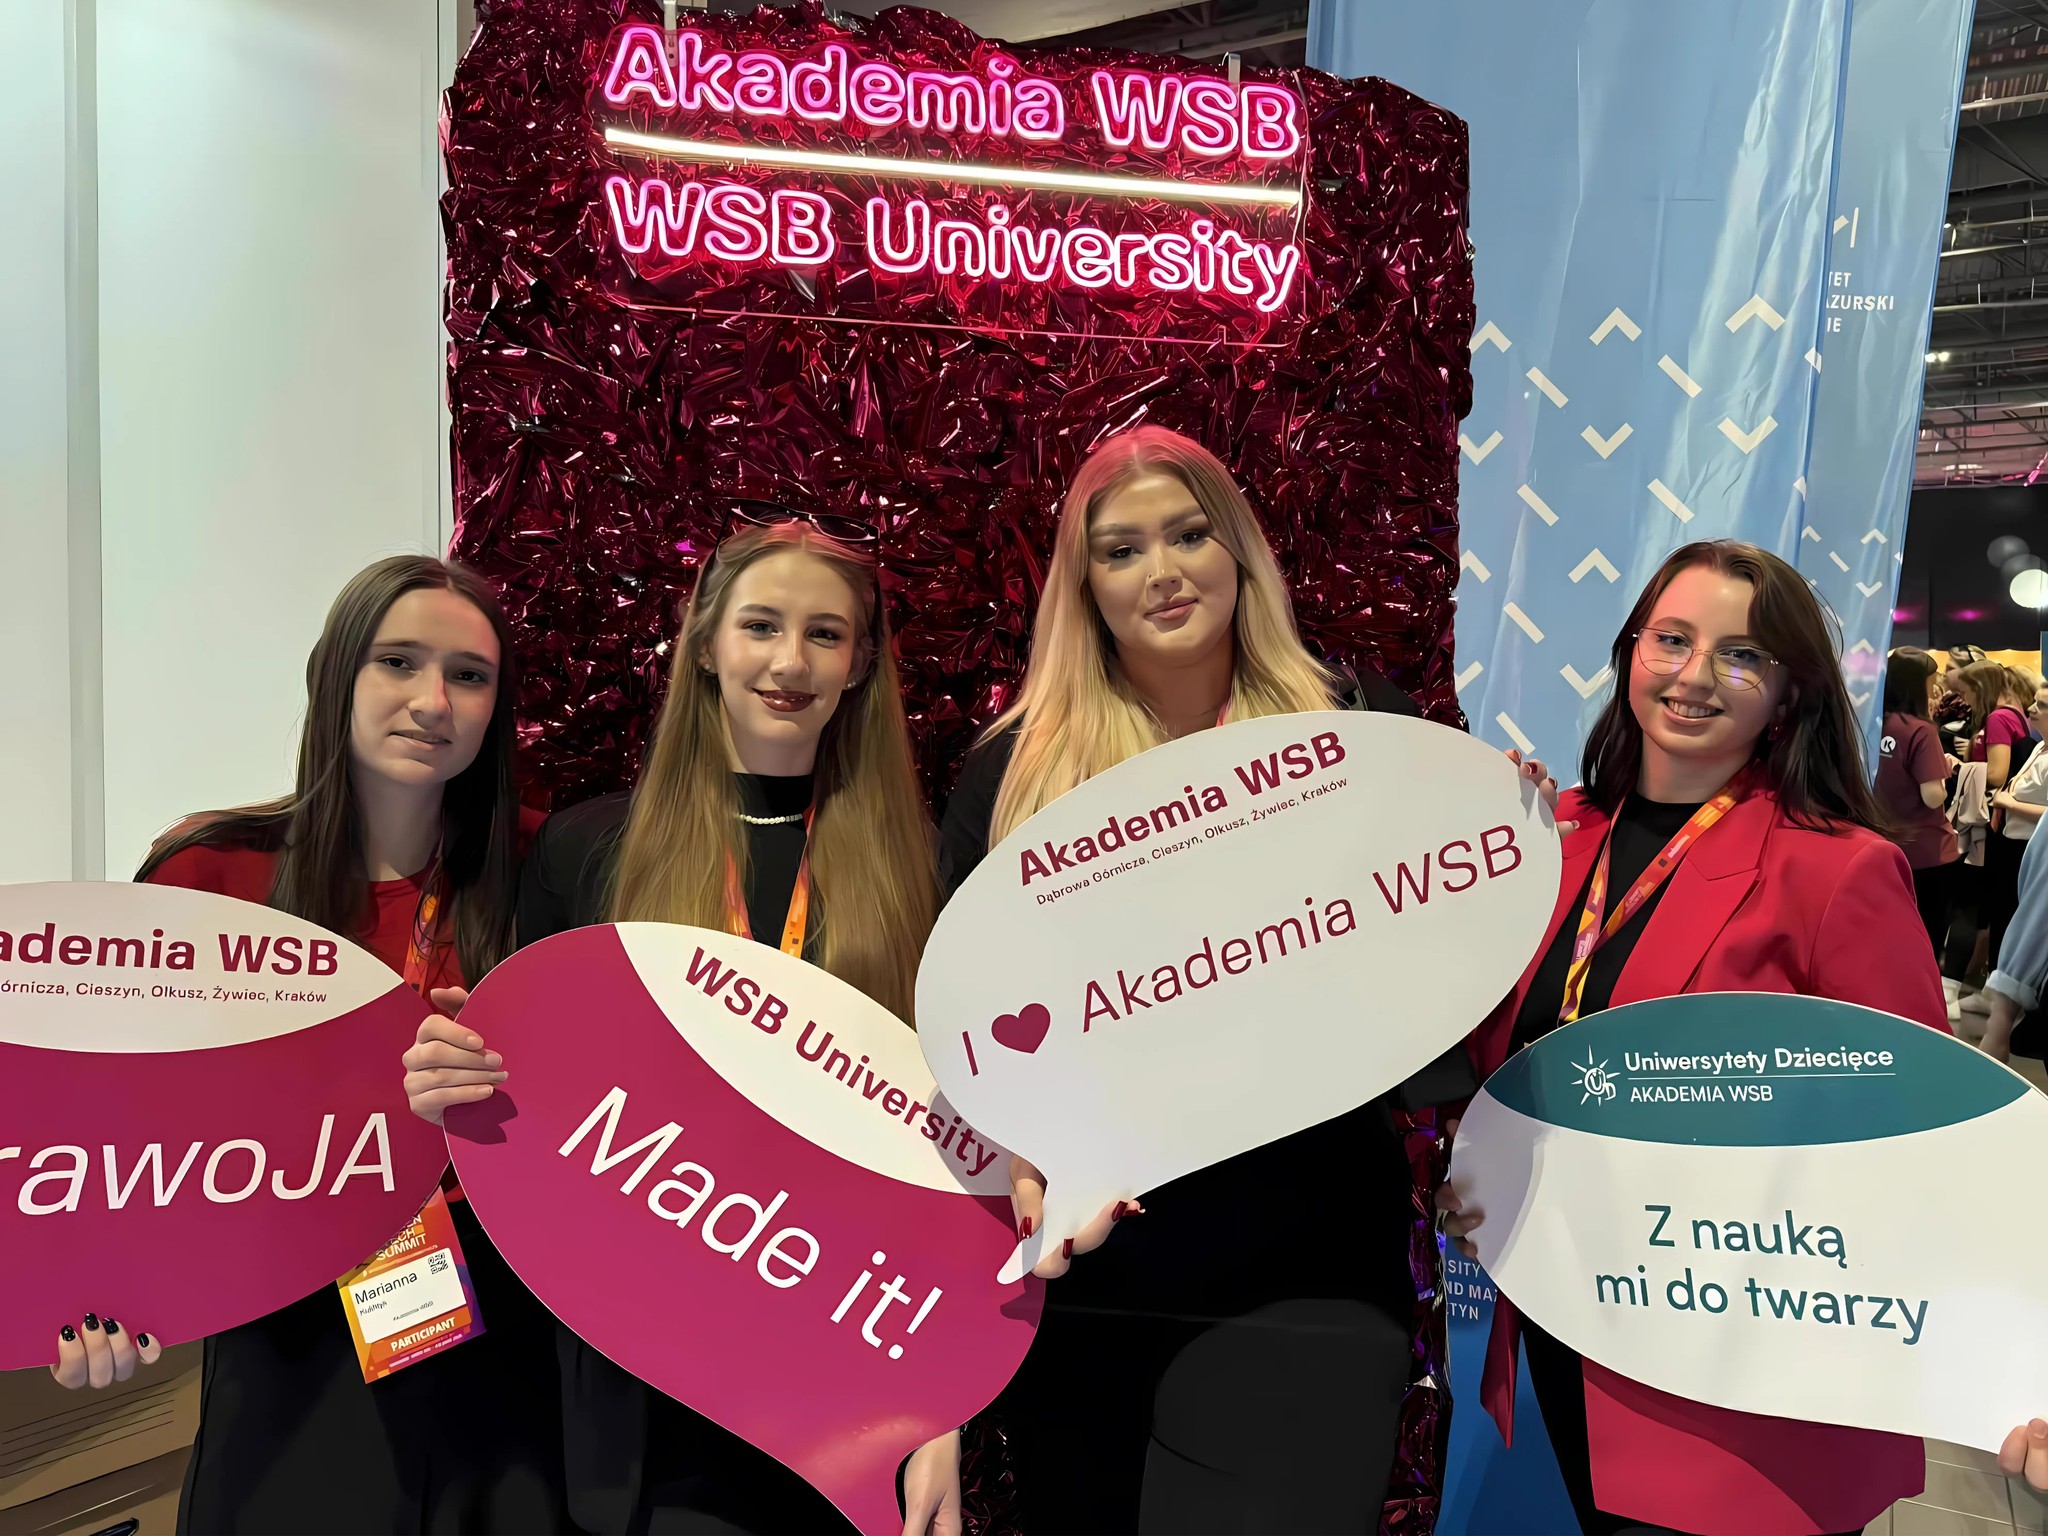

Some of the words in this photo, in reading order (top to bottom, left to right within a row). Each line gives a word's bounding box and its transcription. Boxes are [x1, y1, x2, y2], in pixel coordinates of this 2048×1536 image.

[605, 26, 1065, 139] Akademia
[1091, 71, 1300, 158] WSB
[606, 176, 835, 264] WSB
[866, 198, 1299, 312] University
[1020, 785, 1228, 886] Akademia
[1233, 731, 1347, 796] WSB
[1036, 879, 1091, 905] Dąbrowa
[1092, 857, 1151, 883] Górnicza,
[1151, 836, 1203, 860] Cieszyn,
[1204, 818, 1250, 839] Olkusz,
[1250, 798, 1300, 822] Żywiec,
[1300, 778, 1348, 802] Kraków
[218, 932, 339, 976] WSB
[961, 1030, 980, 1078] I
[1082, 897, 1358, 1034] Akademia
[1373, 824, 1524, 916] WSB
[76, 982, 145, 999] Cieszyn,
[151, 985, 207, 1001] Olkusz,
[212, 986, 269, 1003] Żywiec,
[274, 989, 327, 1004] Kraków
[685, 946, 790, 1035] WSB
[795, 1020, 998, 1177] University
[1624, 1050, 1768, 1076] Uniwersytety
[1773, 1045, 1894, 1071] Dziecięce
[1630, 1086, 1725, 1103] AKADEMIA
[1727, 1085, 1774, 1102] WSB
[557, 1085, 821, 1289] Made
[829, 1250, 944, 1360] it!
[1644, 1204, 1676, 1248] Z
[1691, 1209, 1848, 1269] nauką
[355, 1272, 418, 1305] Marianna
[1595, 1264, 1649, 1307] mi
[1666, 1267, 1729, 1314] do
[1744, 1277, 1929, 1346] twarzy
[390, 1317, 456, 1352] PARTICIPANT
